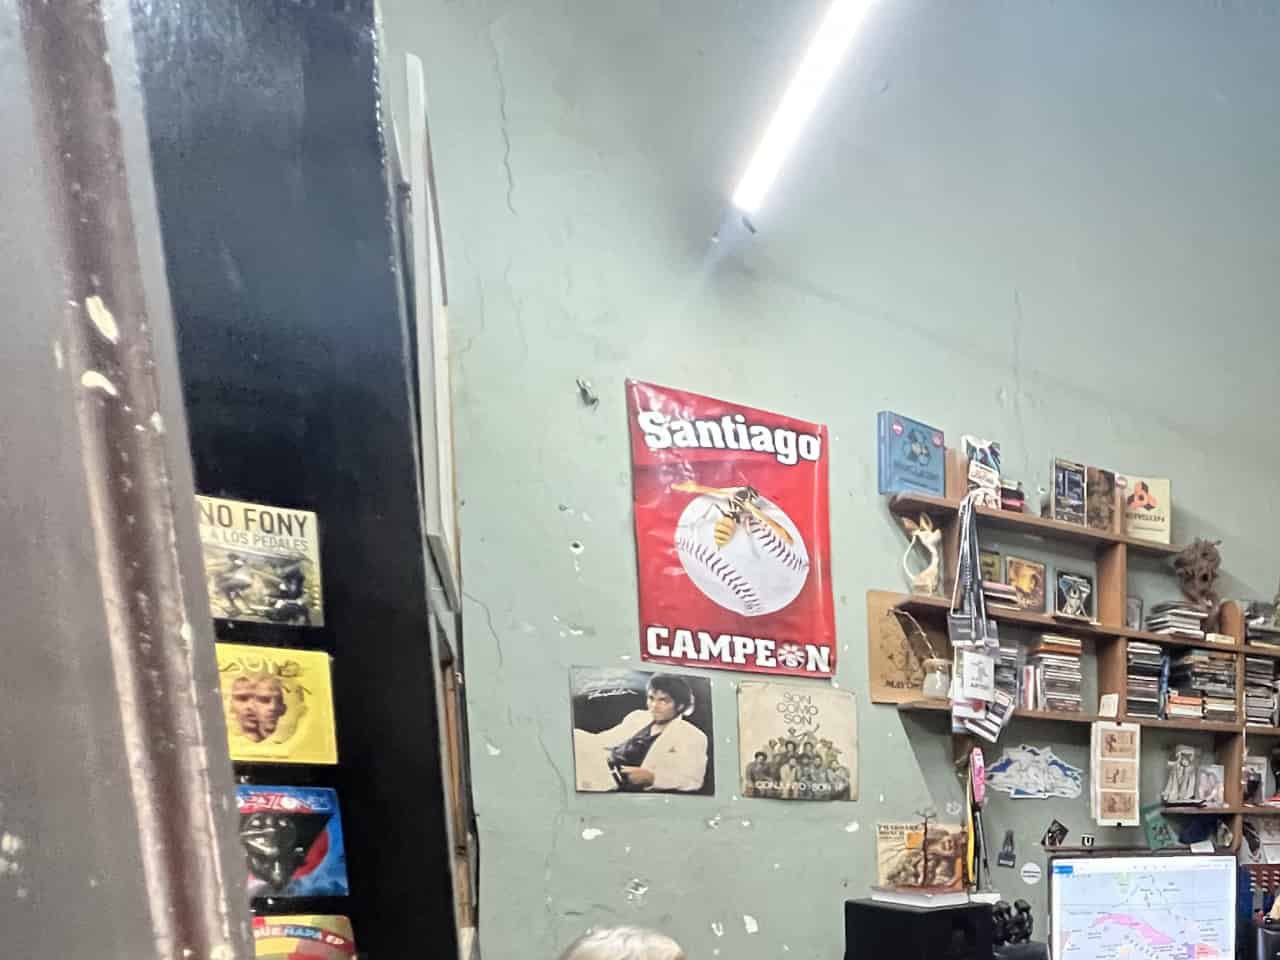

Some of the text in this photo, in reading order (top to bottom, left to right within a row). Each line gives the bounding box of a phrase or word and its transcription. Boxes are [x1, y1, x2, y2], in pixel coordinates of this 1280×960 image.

[638, 410, 820, 465] Santiago
[243, 507, 308, 537] FONY
[222, 530, 250, 546] LOS
[252, 534, 309, 553] PEDALES
[783, 691, 812, 705] SON
[776, 702, 820, 716] COMO
[783, 713, 812, 726] SON
